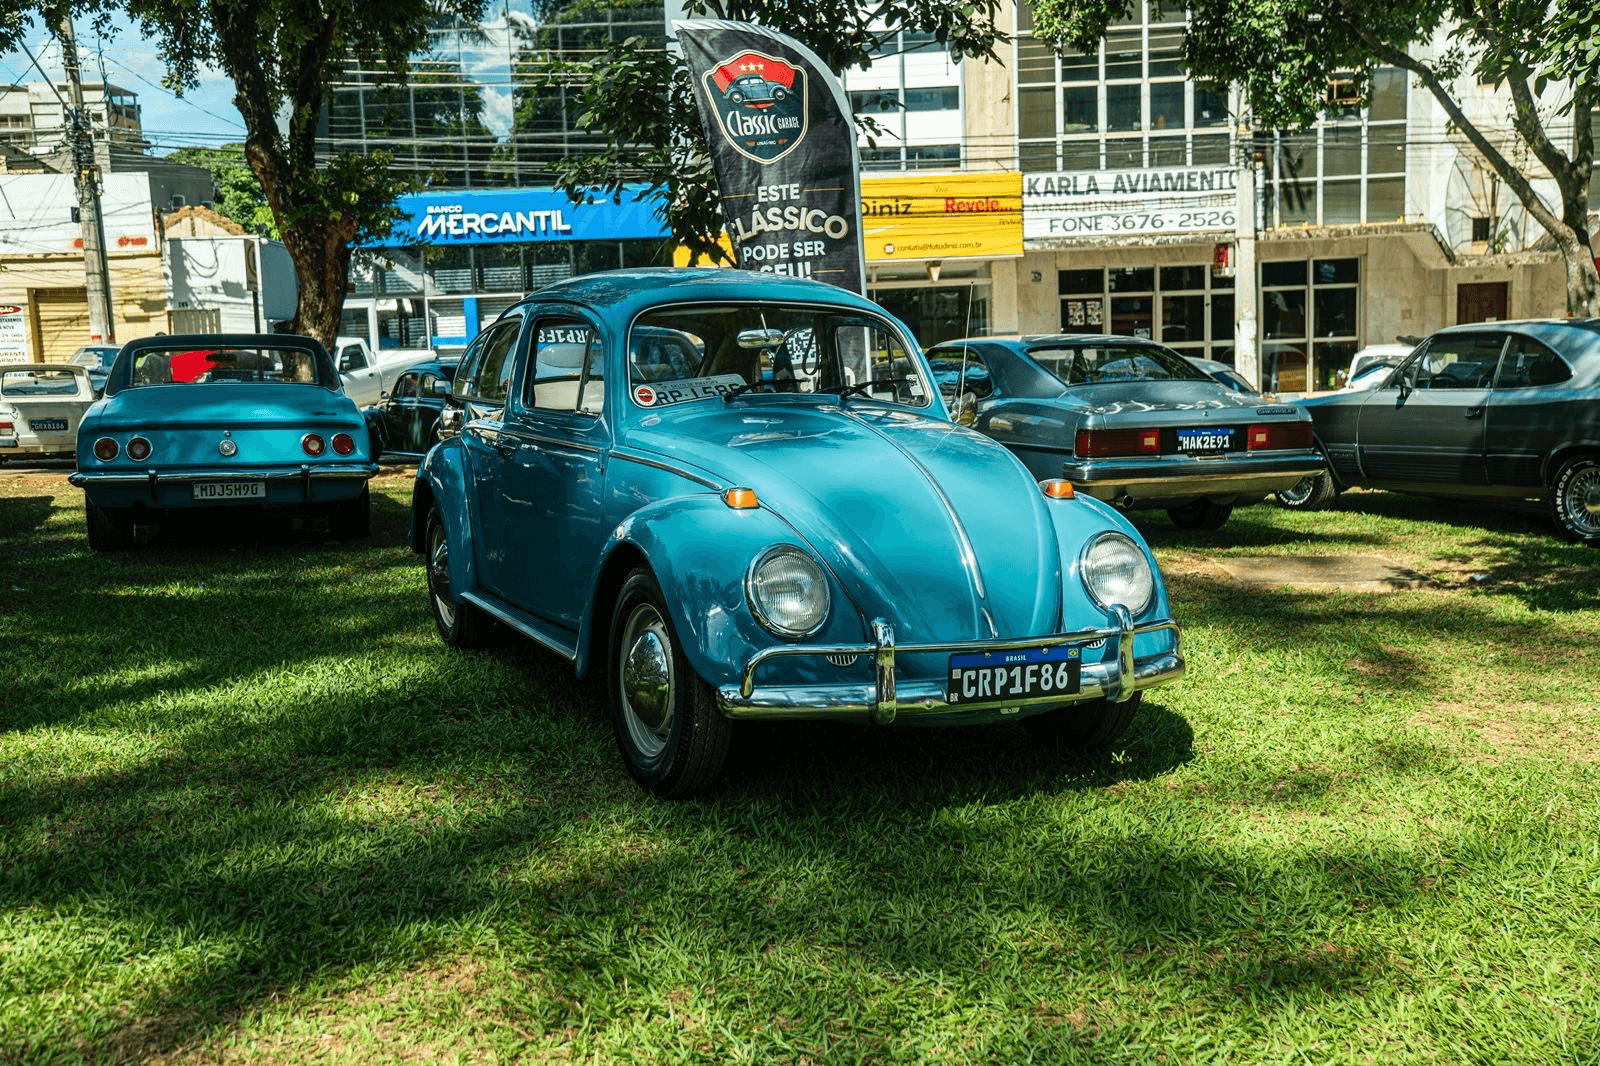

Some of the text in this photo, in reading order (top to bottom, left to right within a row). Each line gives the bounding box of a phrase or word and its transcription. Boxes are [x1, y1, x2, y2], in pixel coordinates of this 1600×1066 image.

[727, 109, 800, 136] Classic GARAGE
[757, 184, 800, 202] ESTE
[1027, 175, 1100, 197] KARLA
[427, 205, 462, 214] BANCO
[861, 199, 912, 216] Diniz
[417, 210, 572, 236] MERCANTIL
[742, 241, 826, 262] PODE SER
[1182, 435, 1230, 450] HAK2E91
[1556, 468, 1573, 521] HANKOOK
[1005, 654, 1027, 662] BRASIL
[962, 662, 1069, 698] CRP1F86
[950, 692, 959, 702] BR
